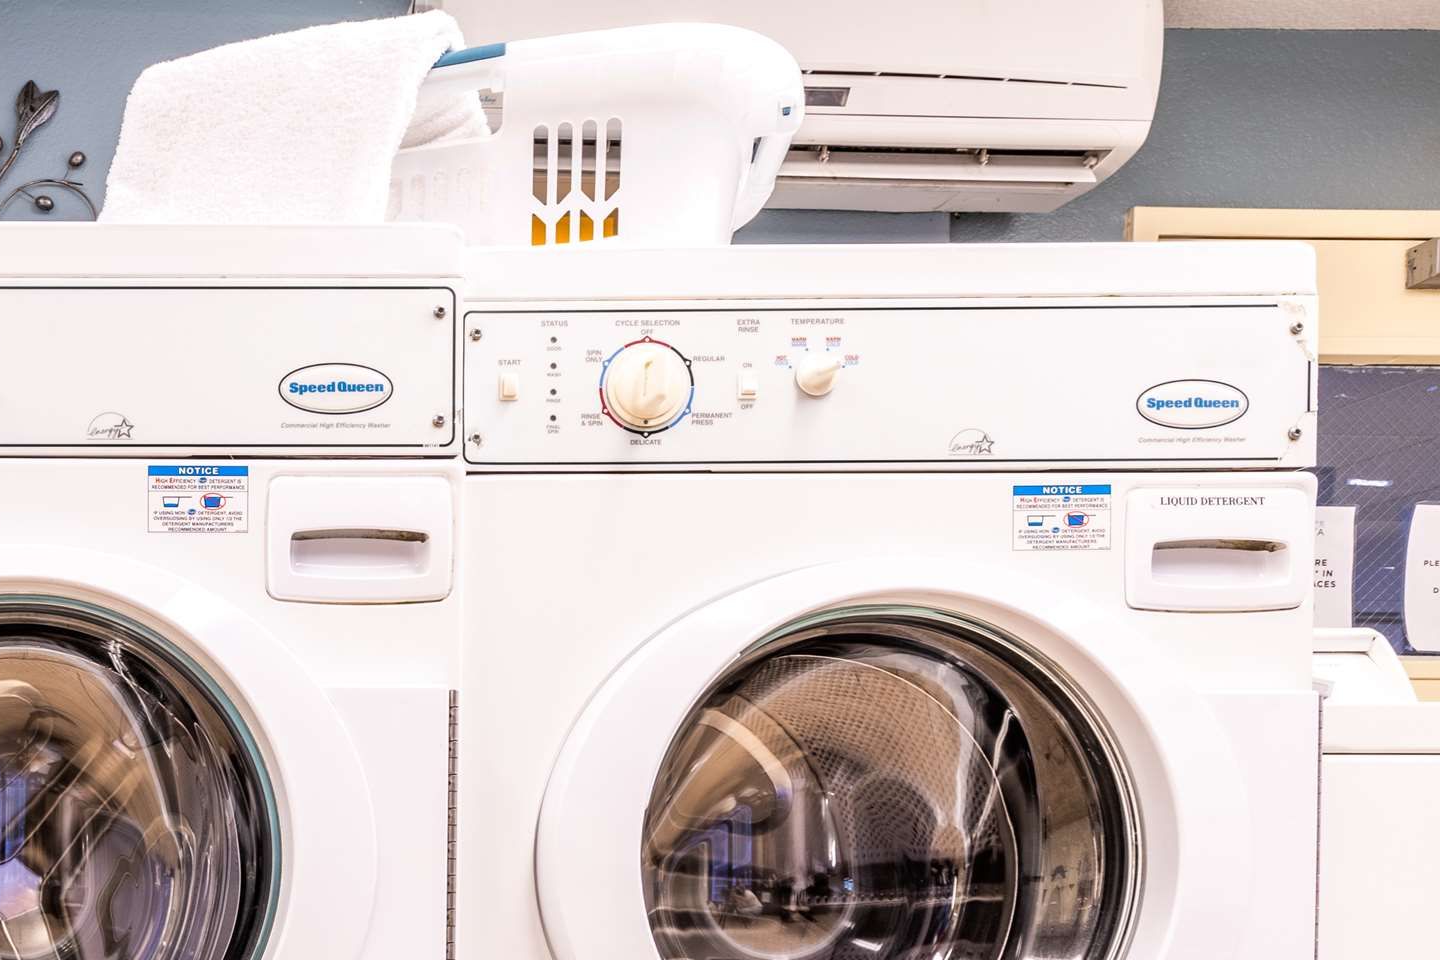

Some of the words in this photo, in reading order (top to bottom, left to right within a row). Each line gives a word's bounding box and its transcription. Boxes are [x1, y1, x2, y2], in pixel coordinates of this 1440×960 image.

[289, 381, 336, 395] Speed
[337, 381, 384, 392] Queen
[1146, 397, 1192, 410] Speed
[1194, 397, 1239, 408] Queen
[319, 422, 334, 430] High
[335, 422, 366, 430] Efficiency
[178, 467, 219, 475] NOTICE
[1042, 486, 1082, 494] NOTICE
[1160, 496, 1198, 506] LIQUID
[1200, 496, 1265, 506] DETERGENT
